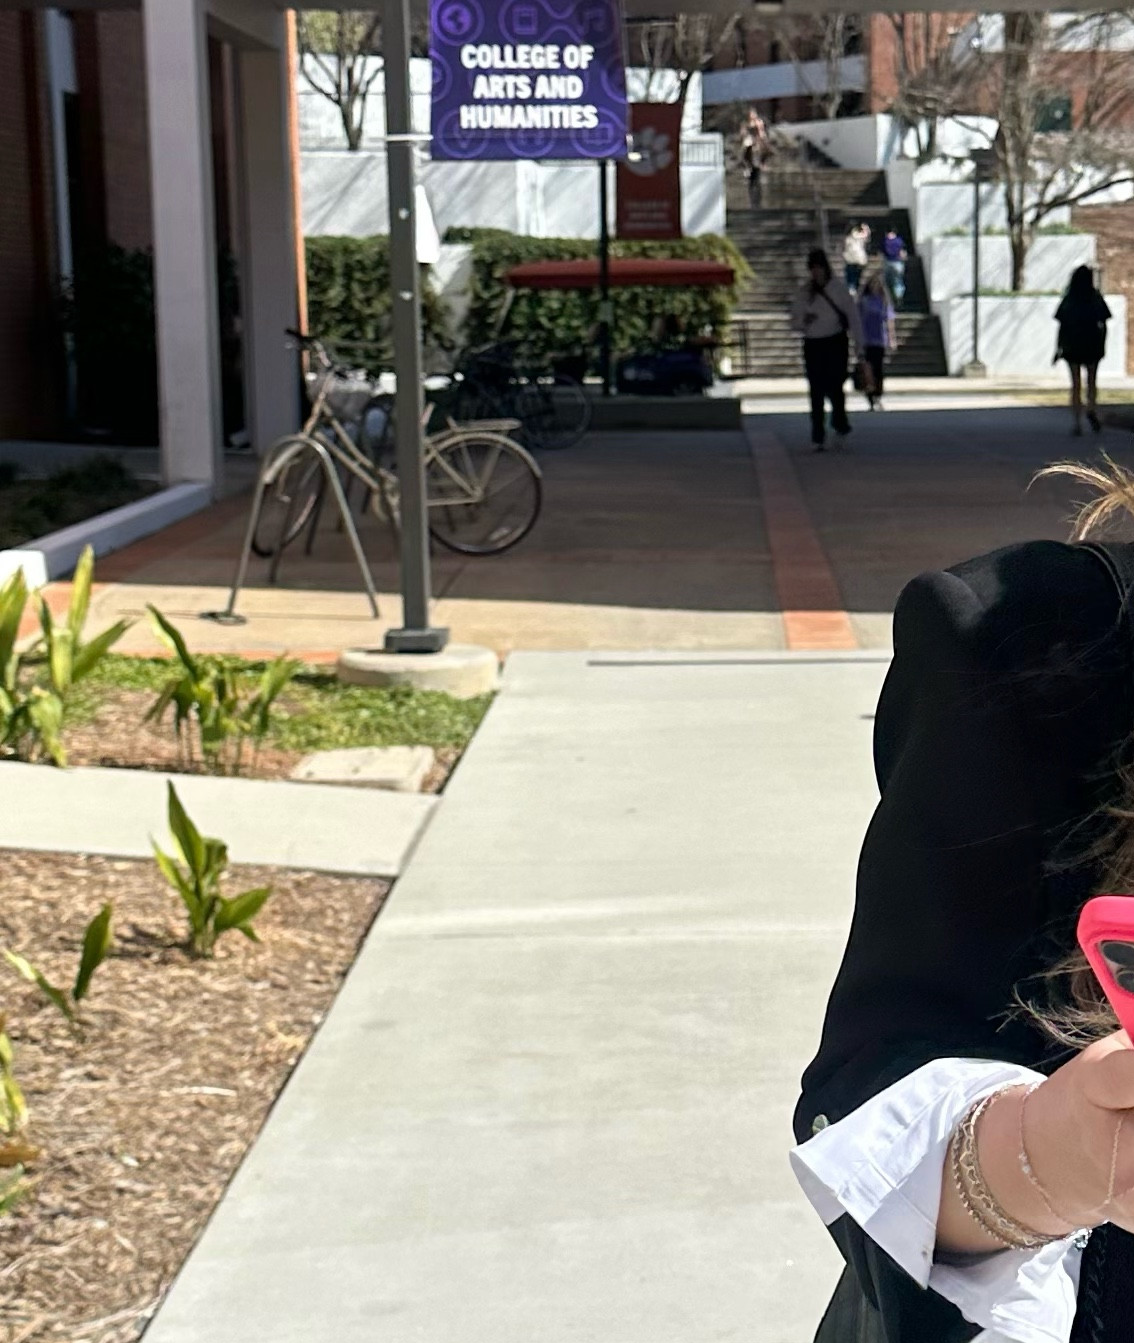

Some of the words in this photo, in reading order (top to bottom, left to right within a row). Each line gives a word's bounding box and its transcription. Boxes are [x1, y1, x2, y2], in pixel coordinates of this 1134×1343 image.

[460, 43, 561, 69] COLLEGE
[563, 44, 595, 69] OF
[473, 74, 532, 99] ARTS
[534, 74, 584, 99] AND
[460, 104, 599, 129] HUMANITIES
